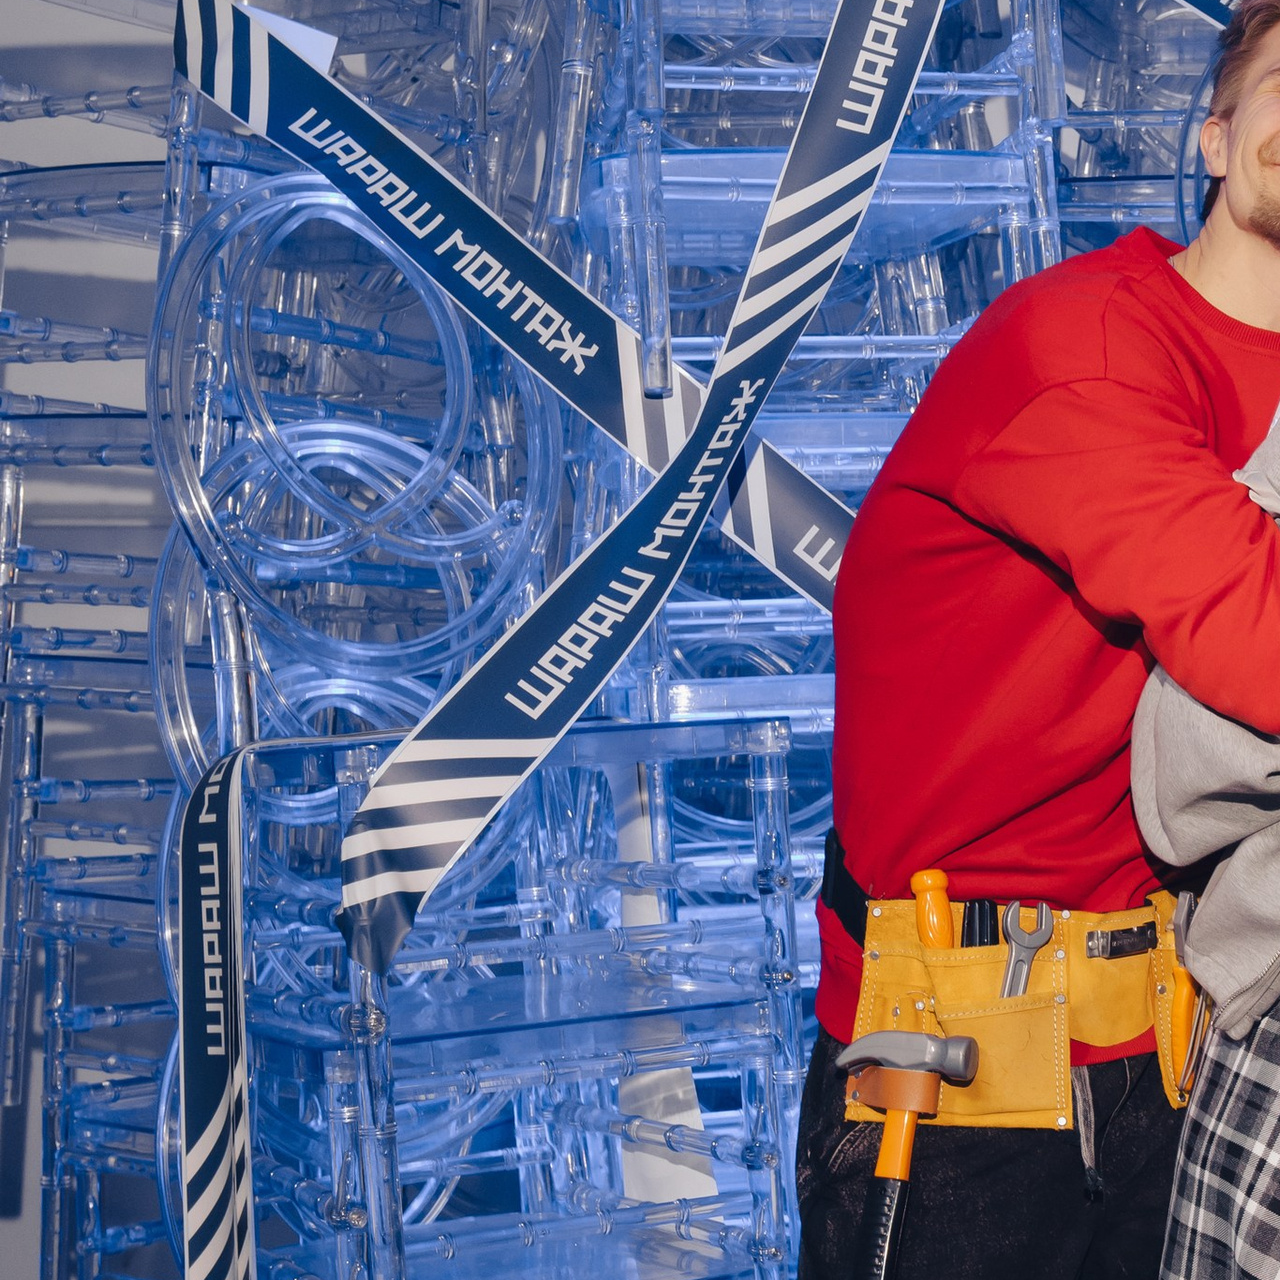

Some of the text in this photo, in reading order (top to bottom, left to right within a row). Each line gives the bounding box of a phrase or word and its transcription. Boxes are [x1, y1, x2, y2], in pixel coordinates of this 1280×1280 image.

[287, 107, 600, 376] ШАРАШ МОНТАЖ
[504, 378, 766, 721] ШАРАШ МОНТАЖ
[197, 842, 226, 1056] ШАРАШ
